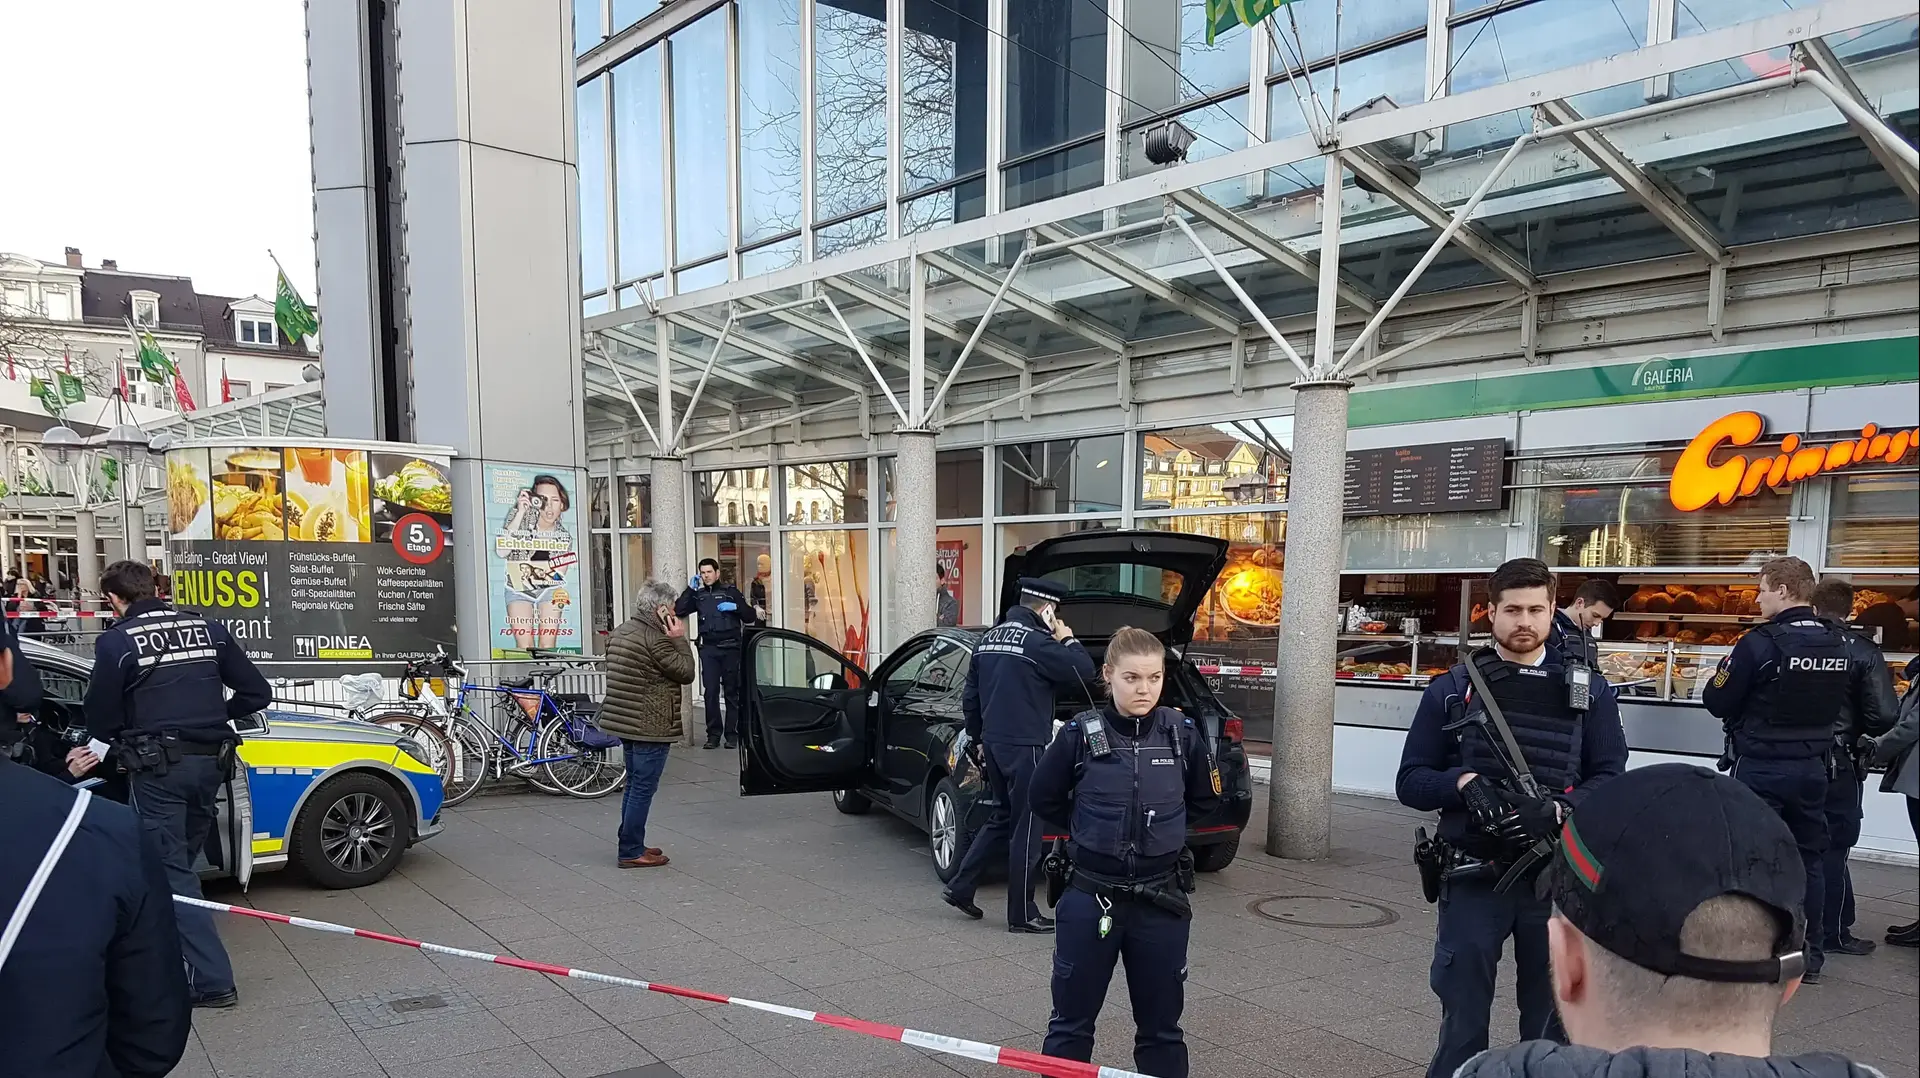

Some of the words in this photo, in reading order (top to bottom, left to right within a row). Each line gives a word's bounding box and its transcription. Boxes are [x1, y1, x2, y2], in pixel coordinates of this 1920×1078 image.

[1643, 367, 1694, 385] GALERIA
[409, 524, 430, 543] 5.
[407, 543, 432, 552] Etage
[497, 538, 568, 550] EchteBilder
[185, 552, 203, 567] Eating
[212, 551, 237, 565] Great
[239, 552, 268, 565] View!
[289, 552, 356, 562] Frühstücks-Buffet
[290, 564, 334, 574] Salat-Buffet
[377, 566, 426, 576] Wok-Gerichte
[290, 576, 347, 586] Gemüse-Buffet
[377, 578, 444, 589] Kaffeespezialitäten
[173, 570, 270, 608] ENUSS!
[291, 588, 356, 599] Grill-Spezialitäten
[378, 590, 406, 599] Kuchen
[413, 591, 434, 600] Torten
[291, 601, 328, 611] Regionale
[330, 601, 354, 610] Küche
[378, 602, 405, 611] Frische
[407, 602, 426, 611] Säfte
[505, 616, 567, 626] Untergeschoss
[500, 628, 573, 636] FOTO-EXPRESS
[981, 629, 1029, 645] POLIZEI
[134, 628, 213, 655] POLIZEI
[318, 636, 372, 649] DINEA
[261, 651, 274, 659] Uhr
[1789, 657, 1848, 671] POLIZEI
[1206, 676, 1224, 692] Tag!
